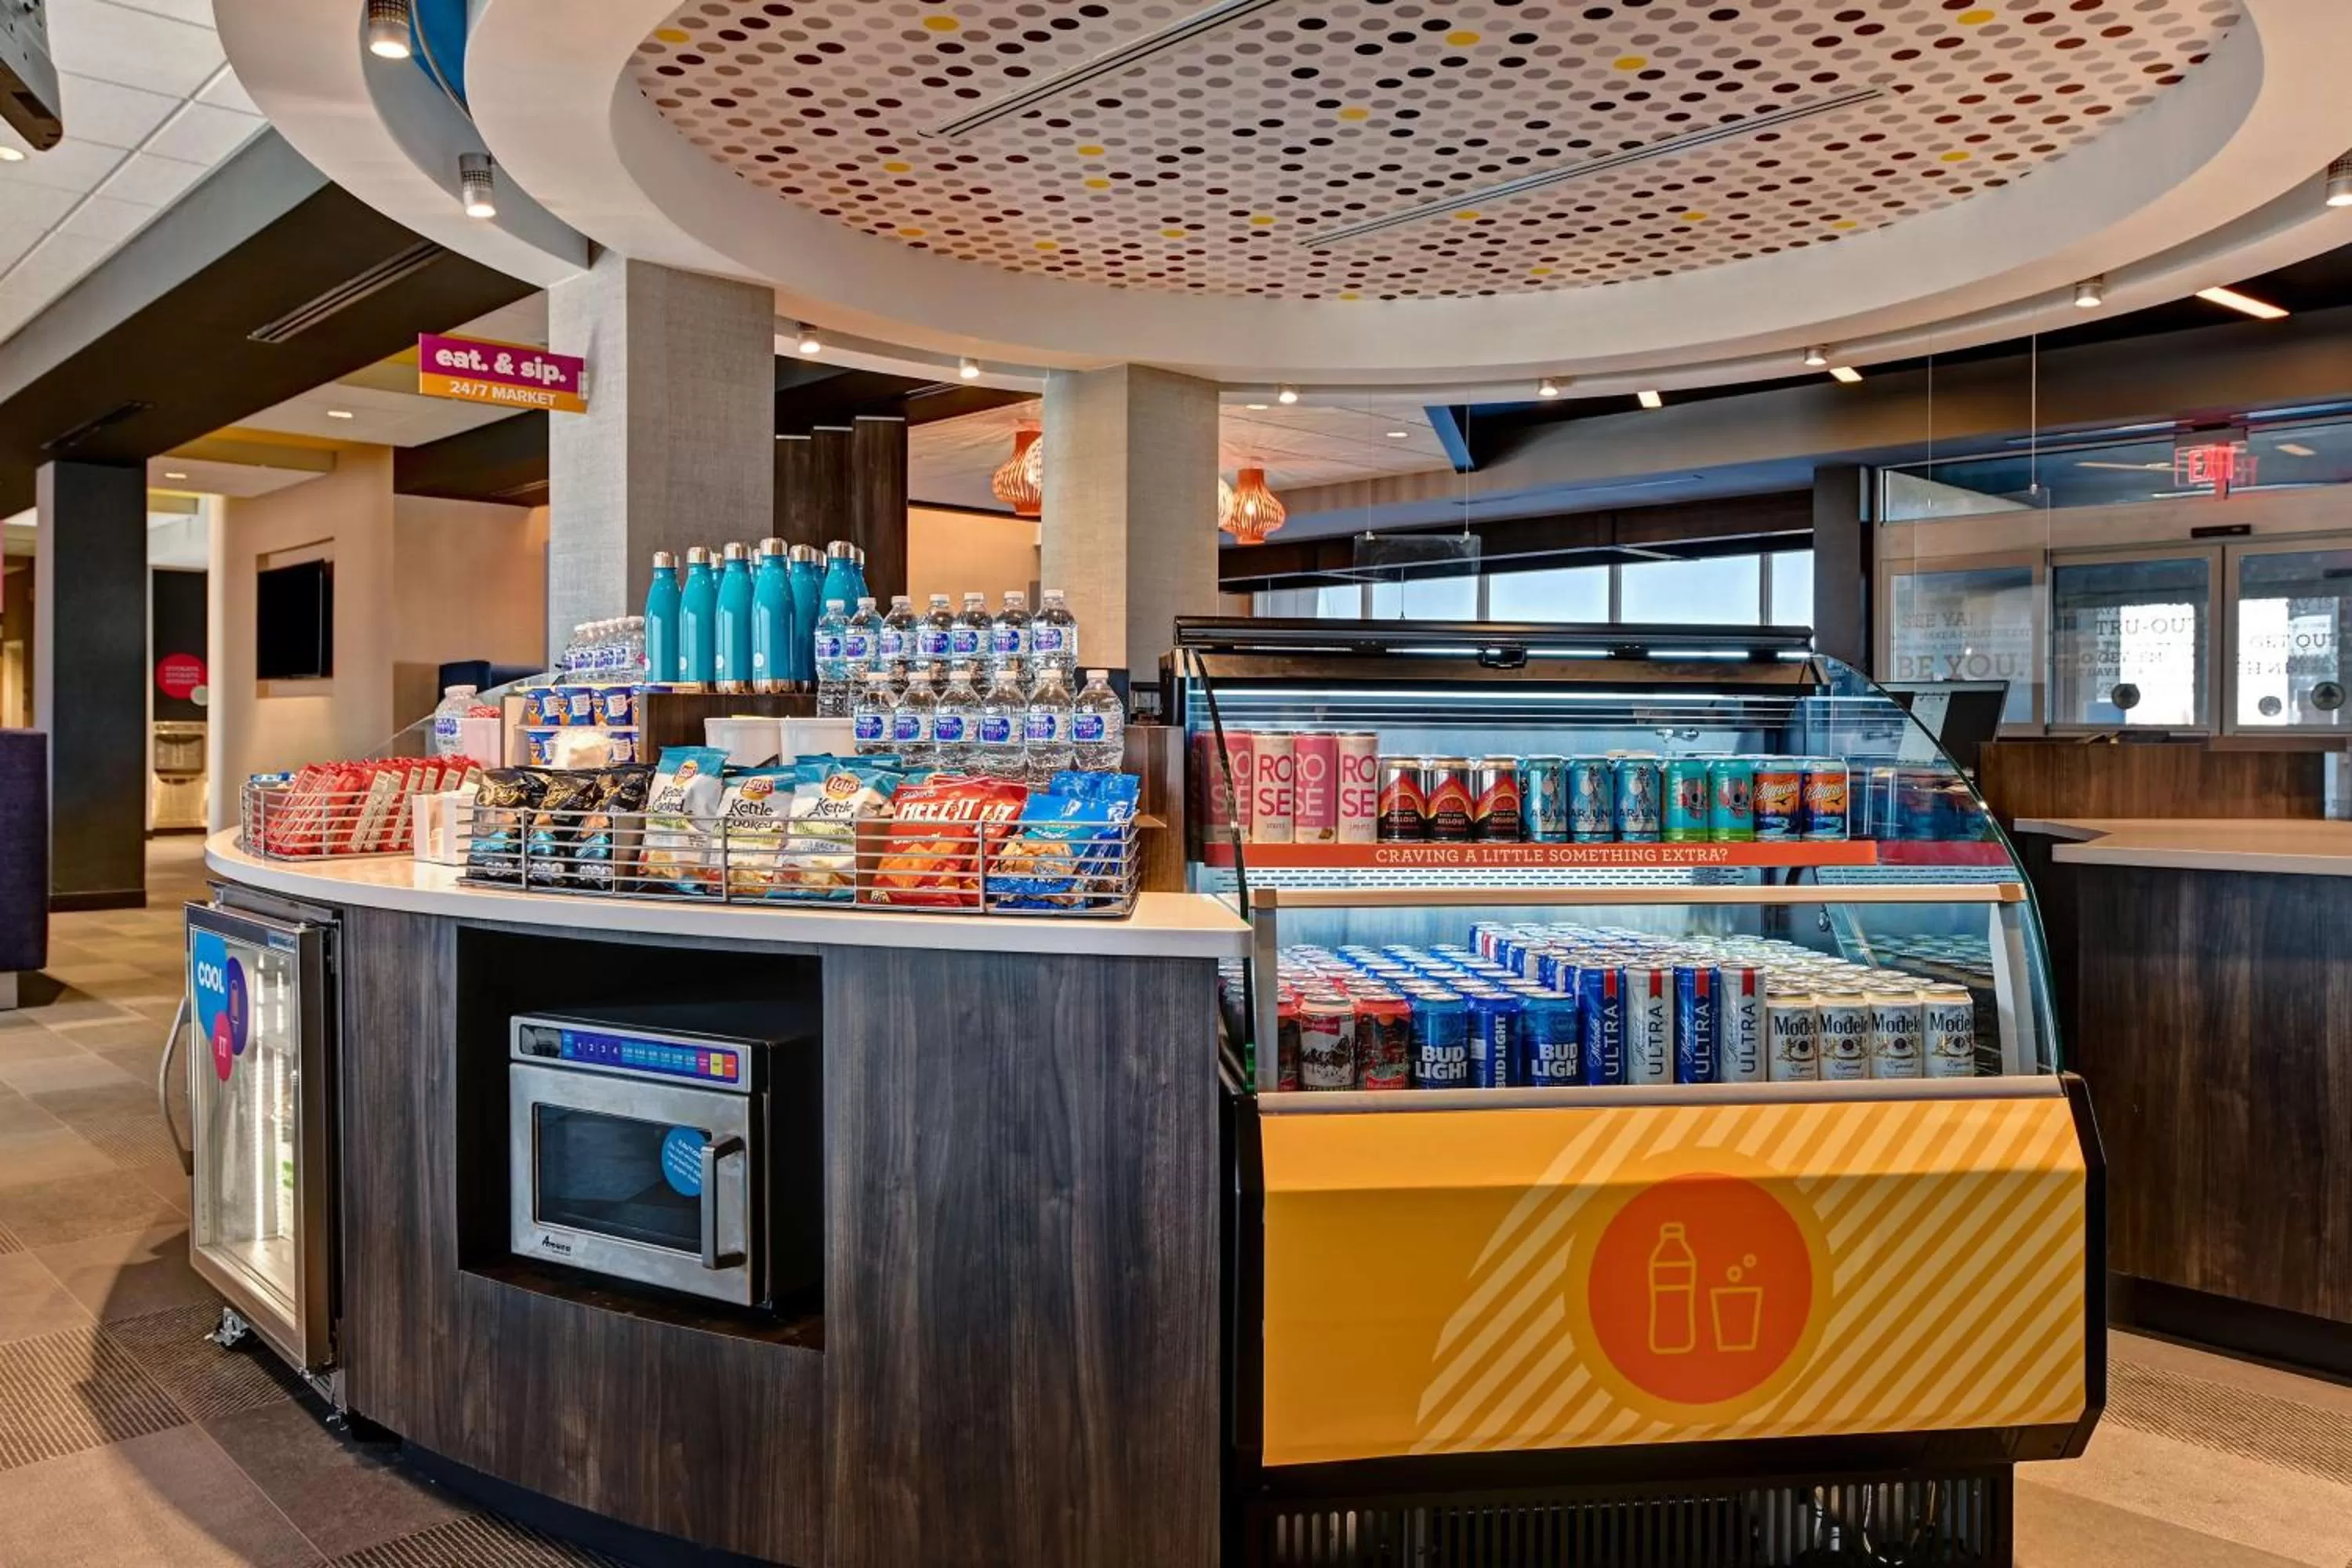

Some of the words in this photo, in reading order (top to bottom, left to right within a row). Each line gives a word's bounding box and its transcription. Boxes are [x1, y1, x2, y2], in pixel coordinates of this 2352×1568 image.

[436, 348, 488, 372] eat.
[494, 352, 514, 376] &
[520, 356, 567, 384] sip.
[449, 380, 488, 397] 24/7
[492, 386, 556, 406] MARKET
[1896, 655, 1935, 679] BE
[1259, 753, 1293, 783] RO
[1342, 755, 1377, 783] RO
[729, 799, 774, 816] Kettle
[1376, 849, 1459, 863] CRAVING
[1465, 849, 1477, 863] A
[1483, 849, 1544, 863] LITTLE
[1548, 848, 1657, 862] SOMETHING
[1662, 848, 1728, 862] EXTRA?
[198, 960, 225, 995] COOL
[1495, 1015, 1506, 1058] LIGHT
[1603, 1004, 1619, 1076] ULTRA
[1648, 1005, 1664, 1075] ULTRA
[1694, 1003, 1710, 1074] ULTRA
[1740, 1003, 1756, 1073] ULTRA
[1421, 1045, 1465, 1062] BUD
[1539, 1043, 1578, 1060] BUD
[1415, 1061, 1468, 1080] LIGHT
[1495, 1059, 1506, 1088] BUD
[1531, 1059, 1578, 1078] LIGH
